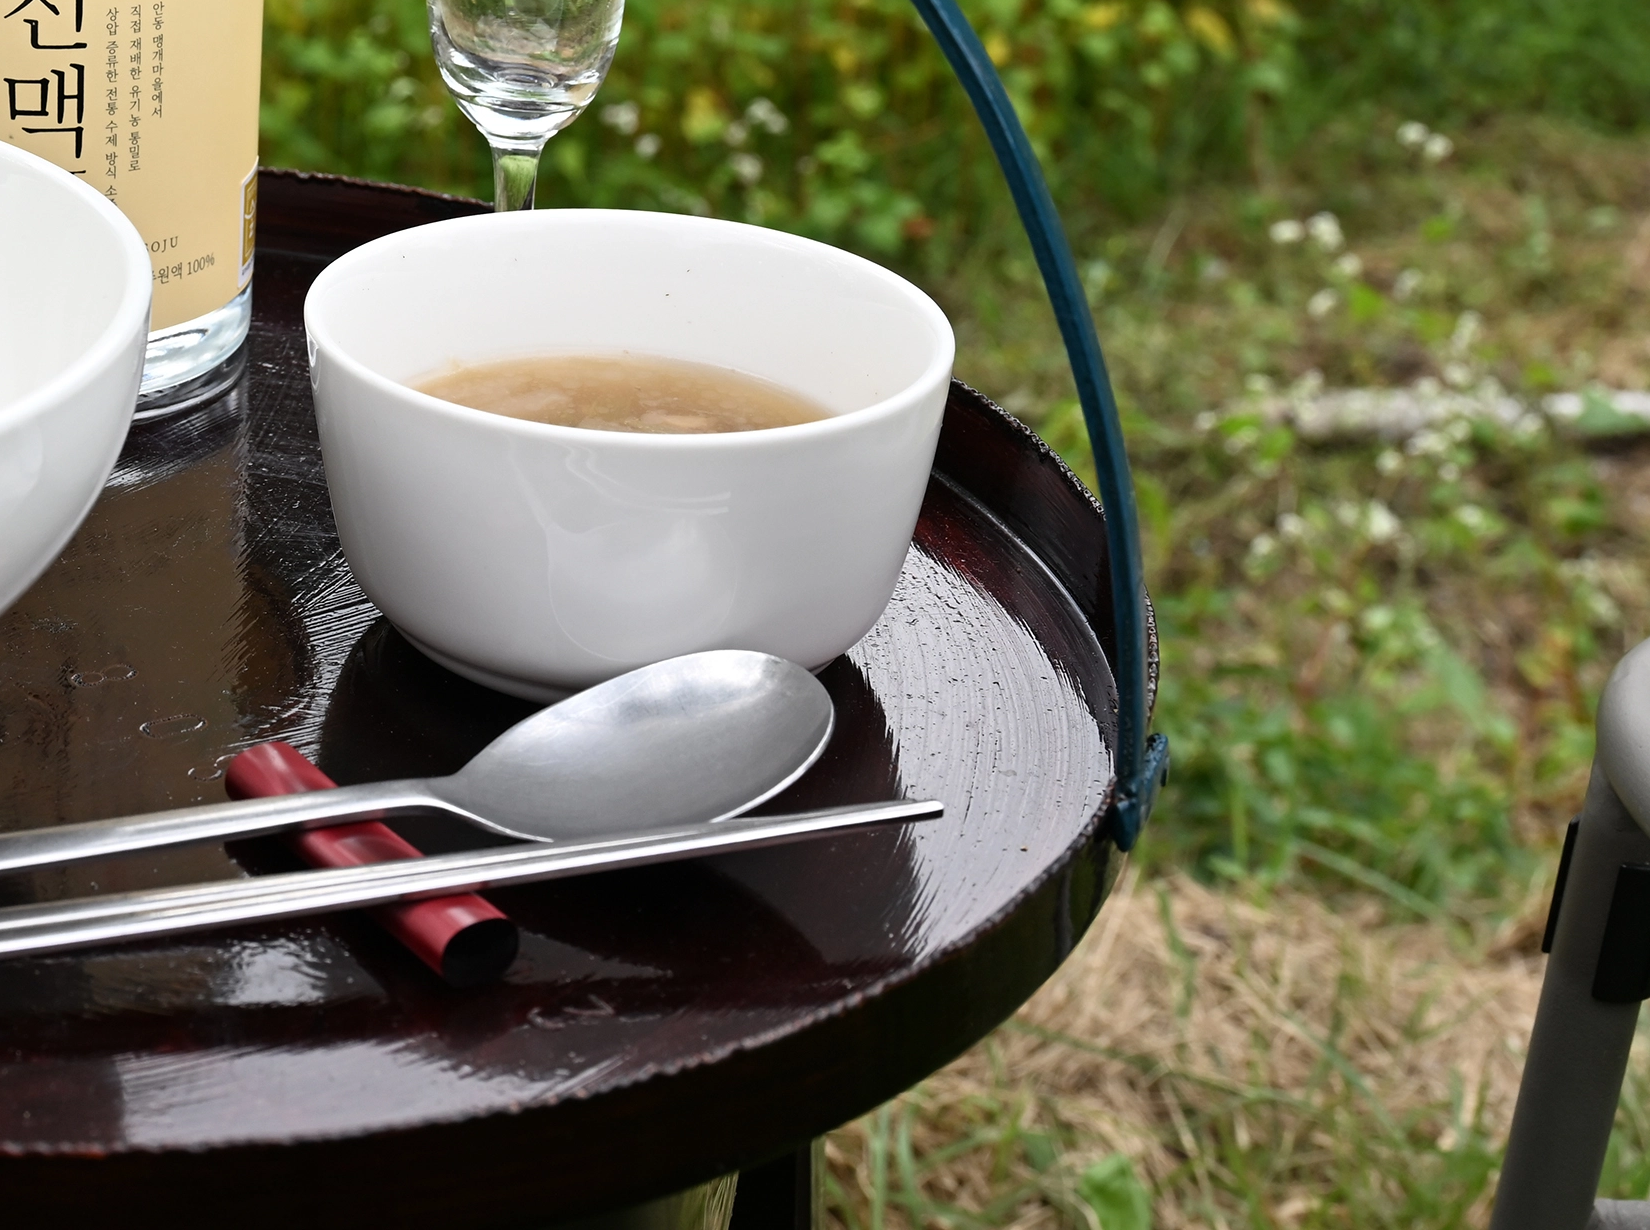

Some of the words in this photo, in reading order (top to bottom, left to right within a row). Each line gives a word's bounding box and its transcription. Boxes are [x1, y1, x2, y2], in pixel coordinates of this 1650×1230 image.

[105, 6, 120, 36] 상압
[130, 4, 142, 34] 직접
[152, 1, 165, 30] 안동
[105, 40, 119, 83] 증류한
[129, 37, 142, 81] 재배한
[151, 33, 164, 119] 맹개마을에서
[105, 86, 119, 116] 전통
[128, 84, 142, 128] 유기농
[105, 120, 119, 147] 수제
[105, 151, 119, 180] 방식
[128, 131, 142, 172] 통밀로
[186, 252, 216, 276] 100%
